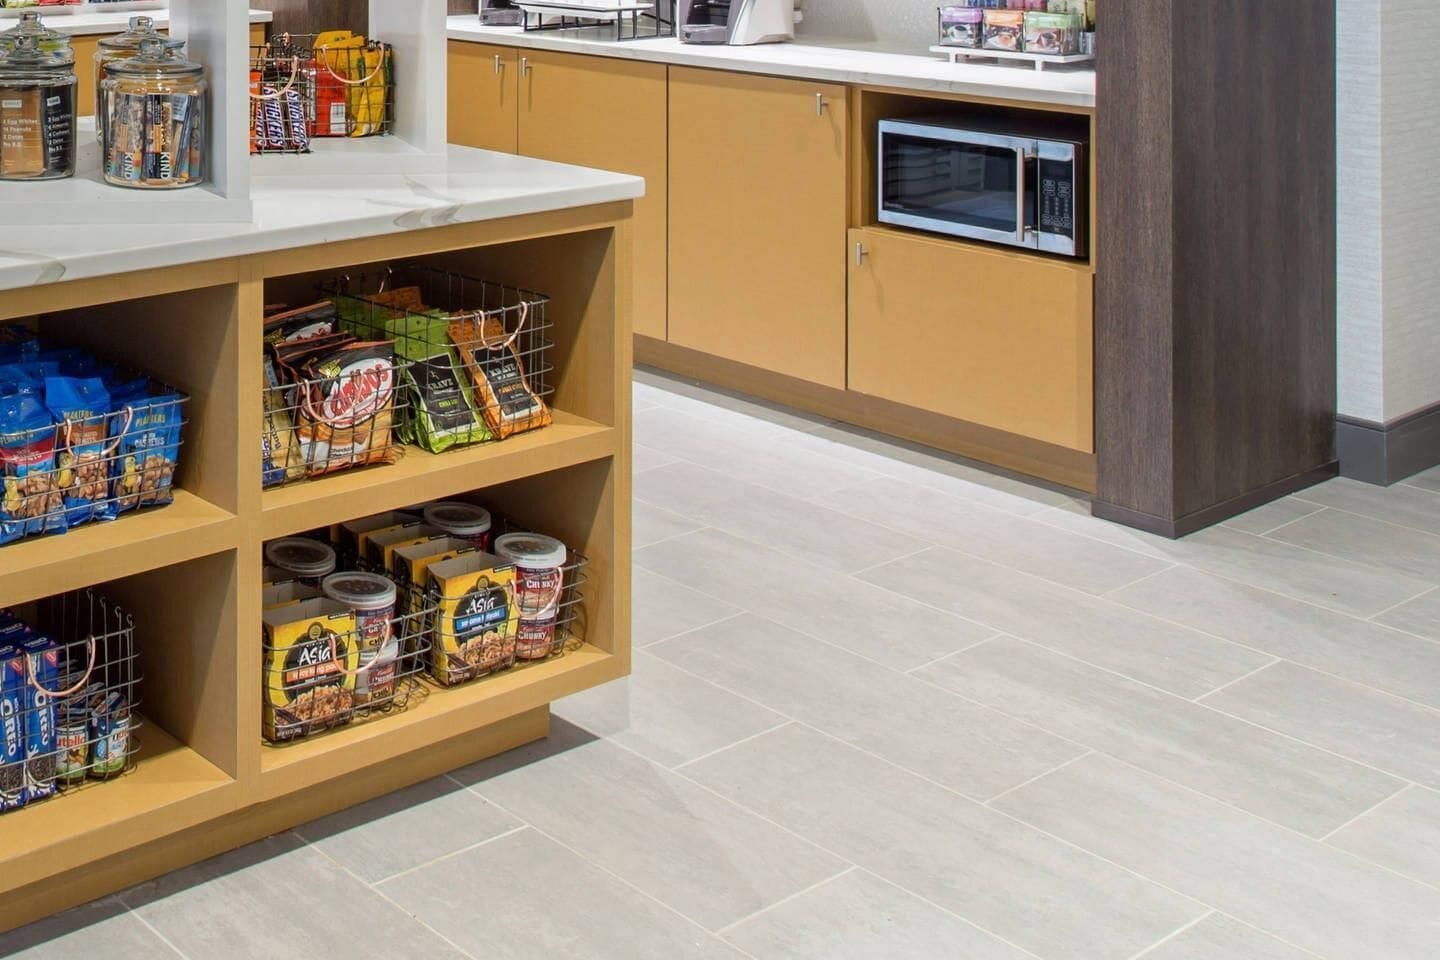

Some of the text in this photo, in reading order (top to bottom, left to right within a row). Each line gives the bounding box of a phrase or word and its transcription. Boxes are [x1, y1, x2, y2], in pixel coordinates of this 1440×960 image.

[124, 152, 134, 180] KIND
[160, 152, 170, 180] KIND
[465, 596, 498, 614] Asia
[297, 644, 332, 666] Asia
[0, 698, 17, 757] OREO
[35, 689, 49, 746] OREO
